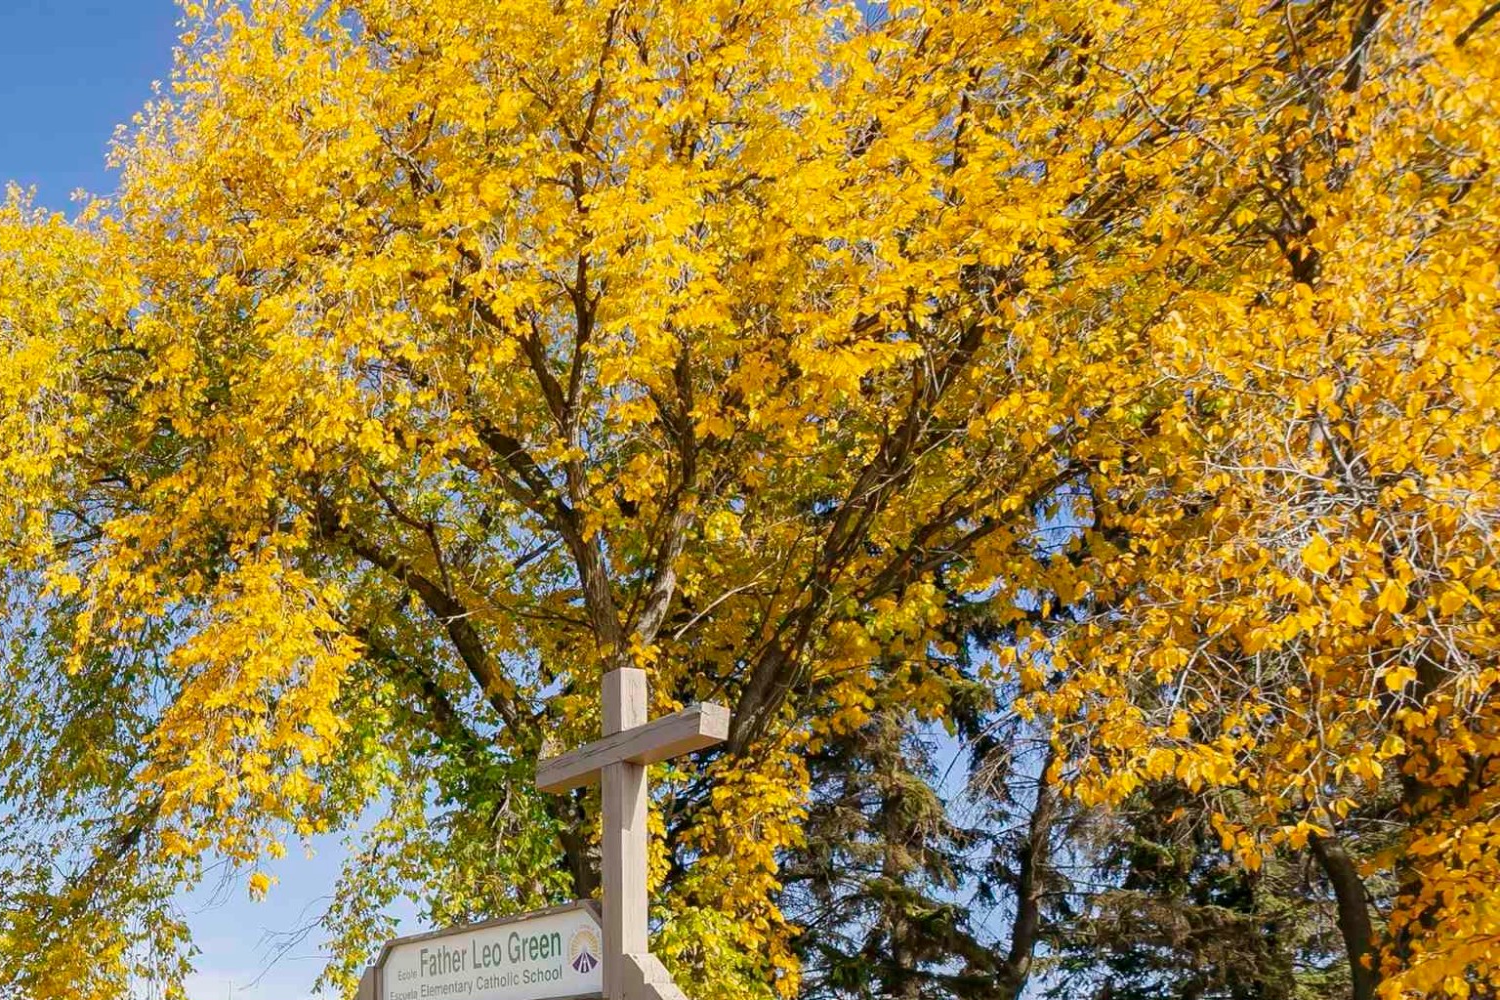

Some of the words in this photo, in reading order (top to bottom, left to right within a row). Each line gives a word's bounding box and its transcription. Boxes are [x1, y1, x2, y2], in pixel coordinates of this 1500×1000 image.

[420, 944, 467, 978] Father
[473, 939, 502, 970] Leo
[508, 931, 562, 963] Green
[420, 977, 473, 998] Elementary
[476, 971, 519, 990] Catholic
[522, 966, 563, 984] School
